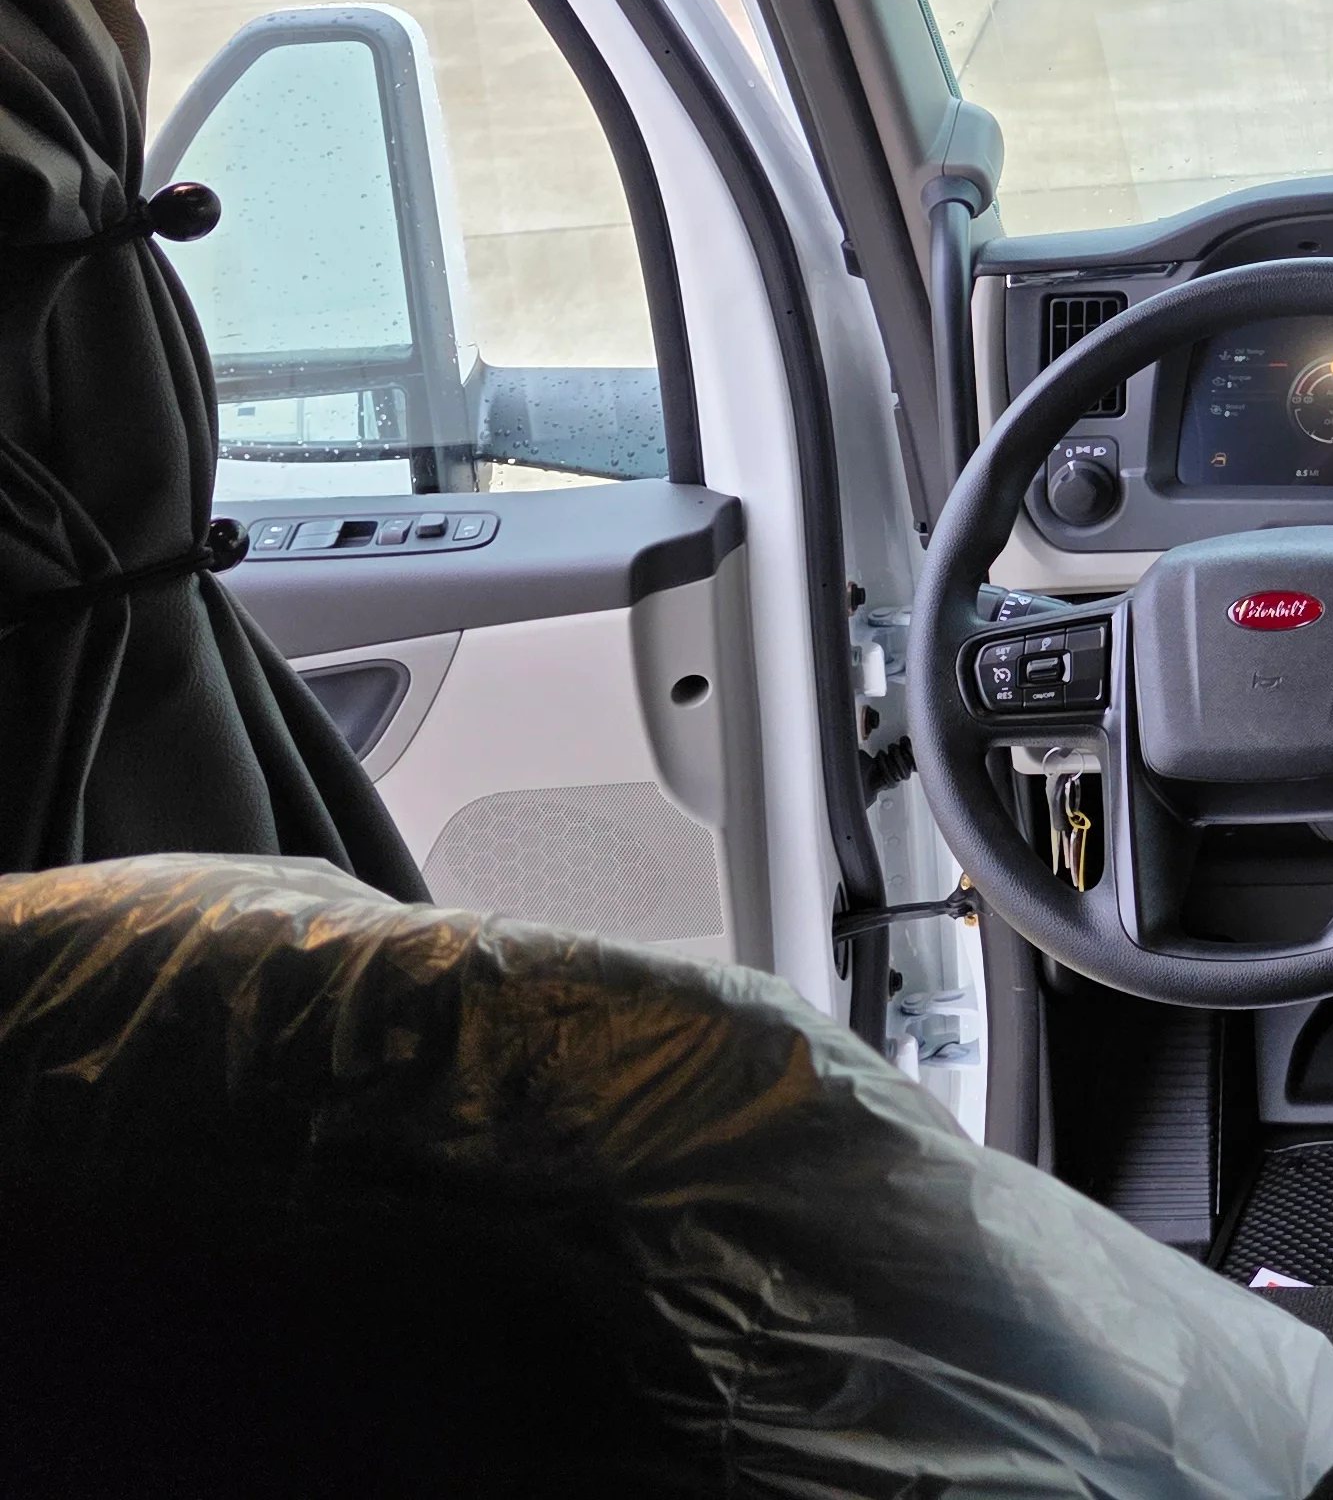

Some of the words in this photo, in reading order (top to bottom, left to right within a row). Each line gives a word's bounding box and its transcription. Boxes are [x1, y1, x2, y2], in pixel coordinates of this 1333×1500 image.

[1235, 599, 1308, 621] Peterbilt
[995, 646, 1011, 656] SET
[996, 691, 1013, 700] RES
